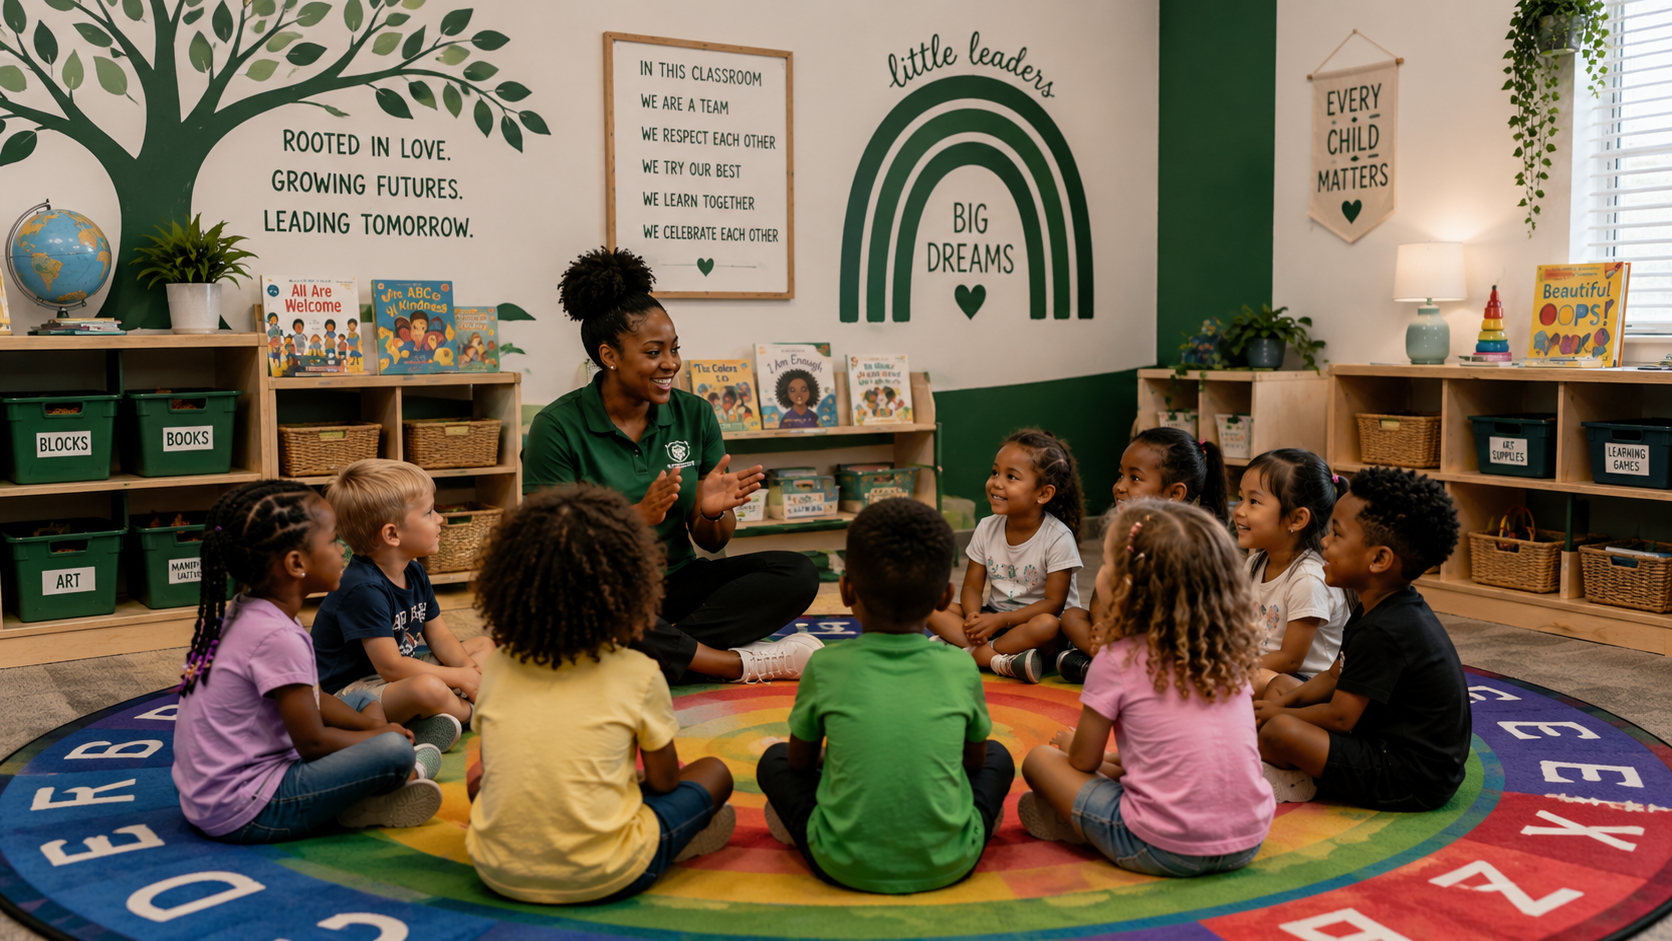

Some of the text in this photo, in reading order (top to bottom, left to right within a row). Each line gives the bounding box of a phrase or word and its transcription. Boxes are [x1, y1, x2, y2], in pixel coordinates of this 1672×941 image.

[640, 59, 762, 87] IN THIS CLASSROOM
[888, 30, 1055, 98] little leaders
[640, 93, 729, 115] WE ARE A TEAM
[1326, 82, 1382, 116] EVERY
[282, 128, 451, 161] ROOTED IN LOVE.
[641, 126, 776, 150] WE RESPECT EACH OTHER
[1326, 123, 1380, 156] CHILD
[641, 158, 742, 179] WE TRY OUR BEST
[1317, 162, 1389, 193] MATTERS
[271, 169, 463, 200] GROWING FUTURES.
[642, 191, 755, 211] WE LEARN TOGETHER
[264, 209, 474, 238] LEADING TOMORROW.
[953, 201, 989, 235] BIG
[642, 224, 779, 243] WE CELEBRATE EACH OTHER
[927, 241, 1015, 275] DREAMS
[291, 283, 333, 298] All Are
[1542, 281, 1612, 300] Beautiful
[284, 298, 342, 313] Welcome
[1538, 298, 1615, 327] OOPS!
[774, 359, 789, 371] Am
[39, 435, 89, 453] BLOCKS
[166, 430, 209, 447] BOOKS
[55, 573, 82, 590] ART
